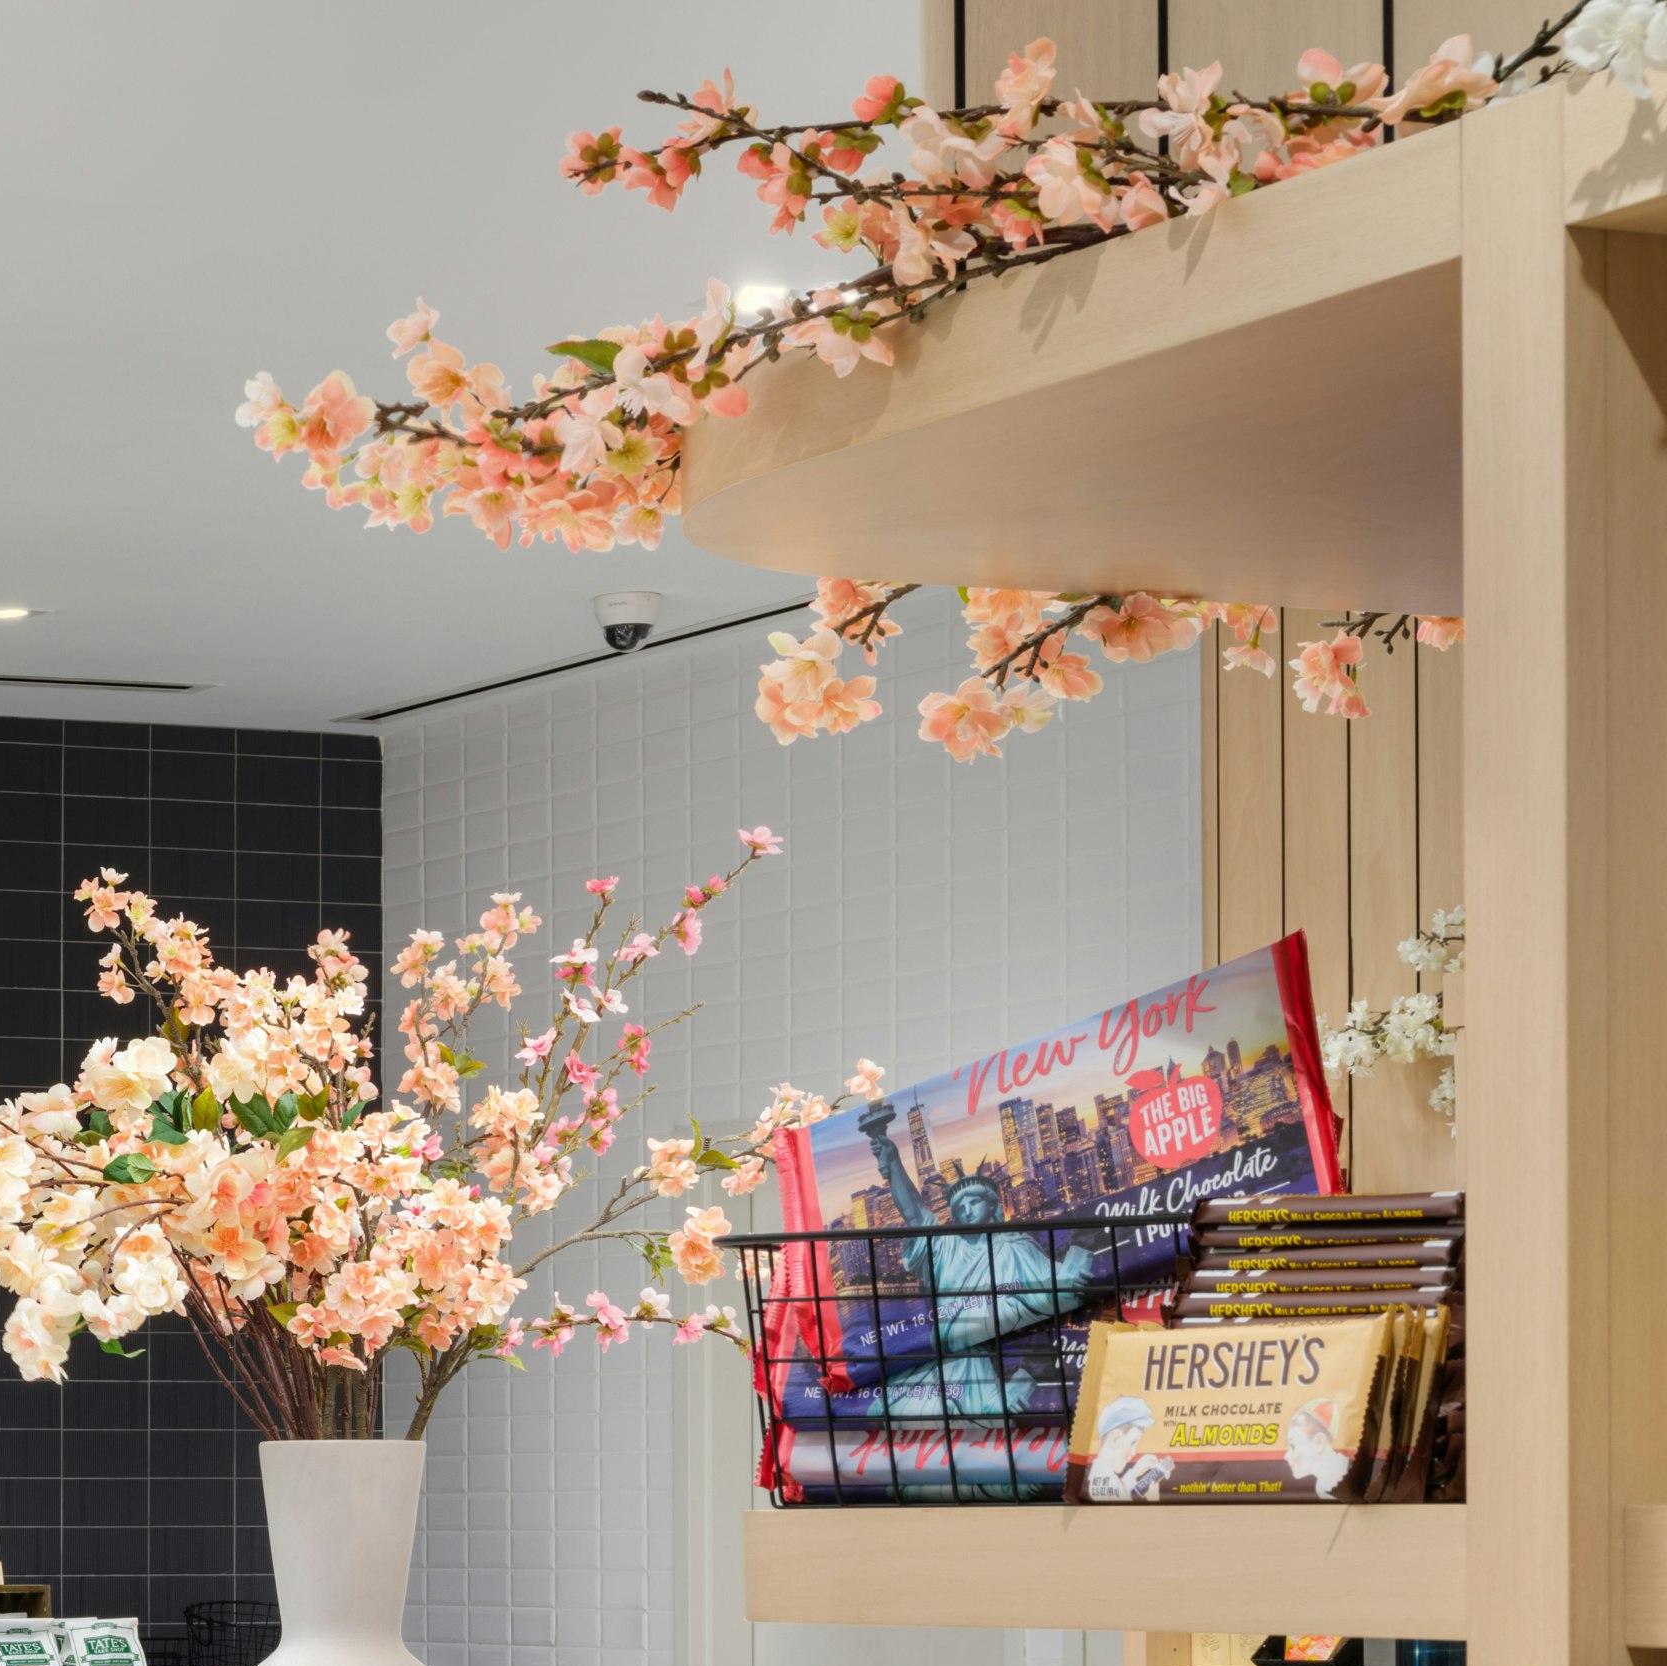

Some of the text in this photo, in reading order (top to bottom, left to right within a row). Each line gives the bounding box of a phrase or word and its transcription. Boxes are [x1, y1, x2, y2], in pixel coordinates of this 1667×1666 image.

[953, 974, 1217, 1116] New York
[1139, 1083, 1209, 1127] THE BIG
[1144, 1108, 1216, 1157] APPLE
[1167, 1147, 1277, 1214] Chocolate
[1228, 1208, 1290, 1223] HERSHEY'S
[1315, 1211, 1362, 1220] CHOCOLATE
[1143, 1334, 1325, 1392] HERSHEY'S
[1164, 1403, 1282, 1417] MILK CHOCOLATE
[1170, 1422, 1279, 1447] ALMONDS
[0, 1643, 40, 1653] TATE'S
[88, 1636, 127, 1649] TATE'S
